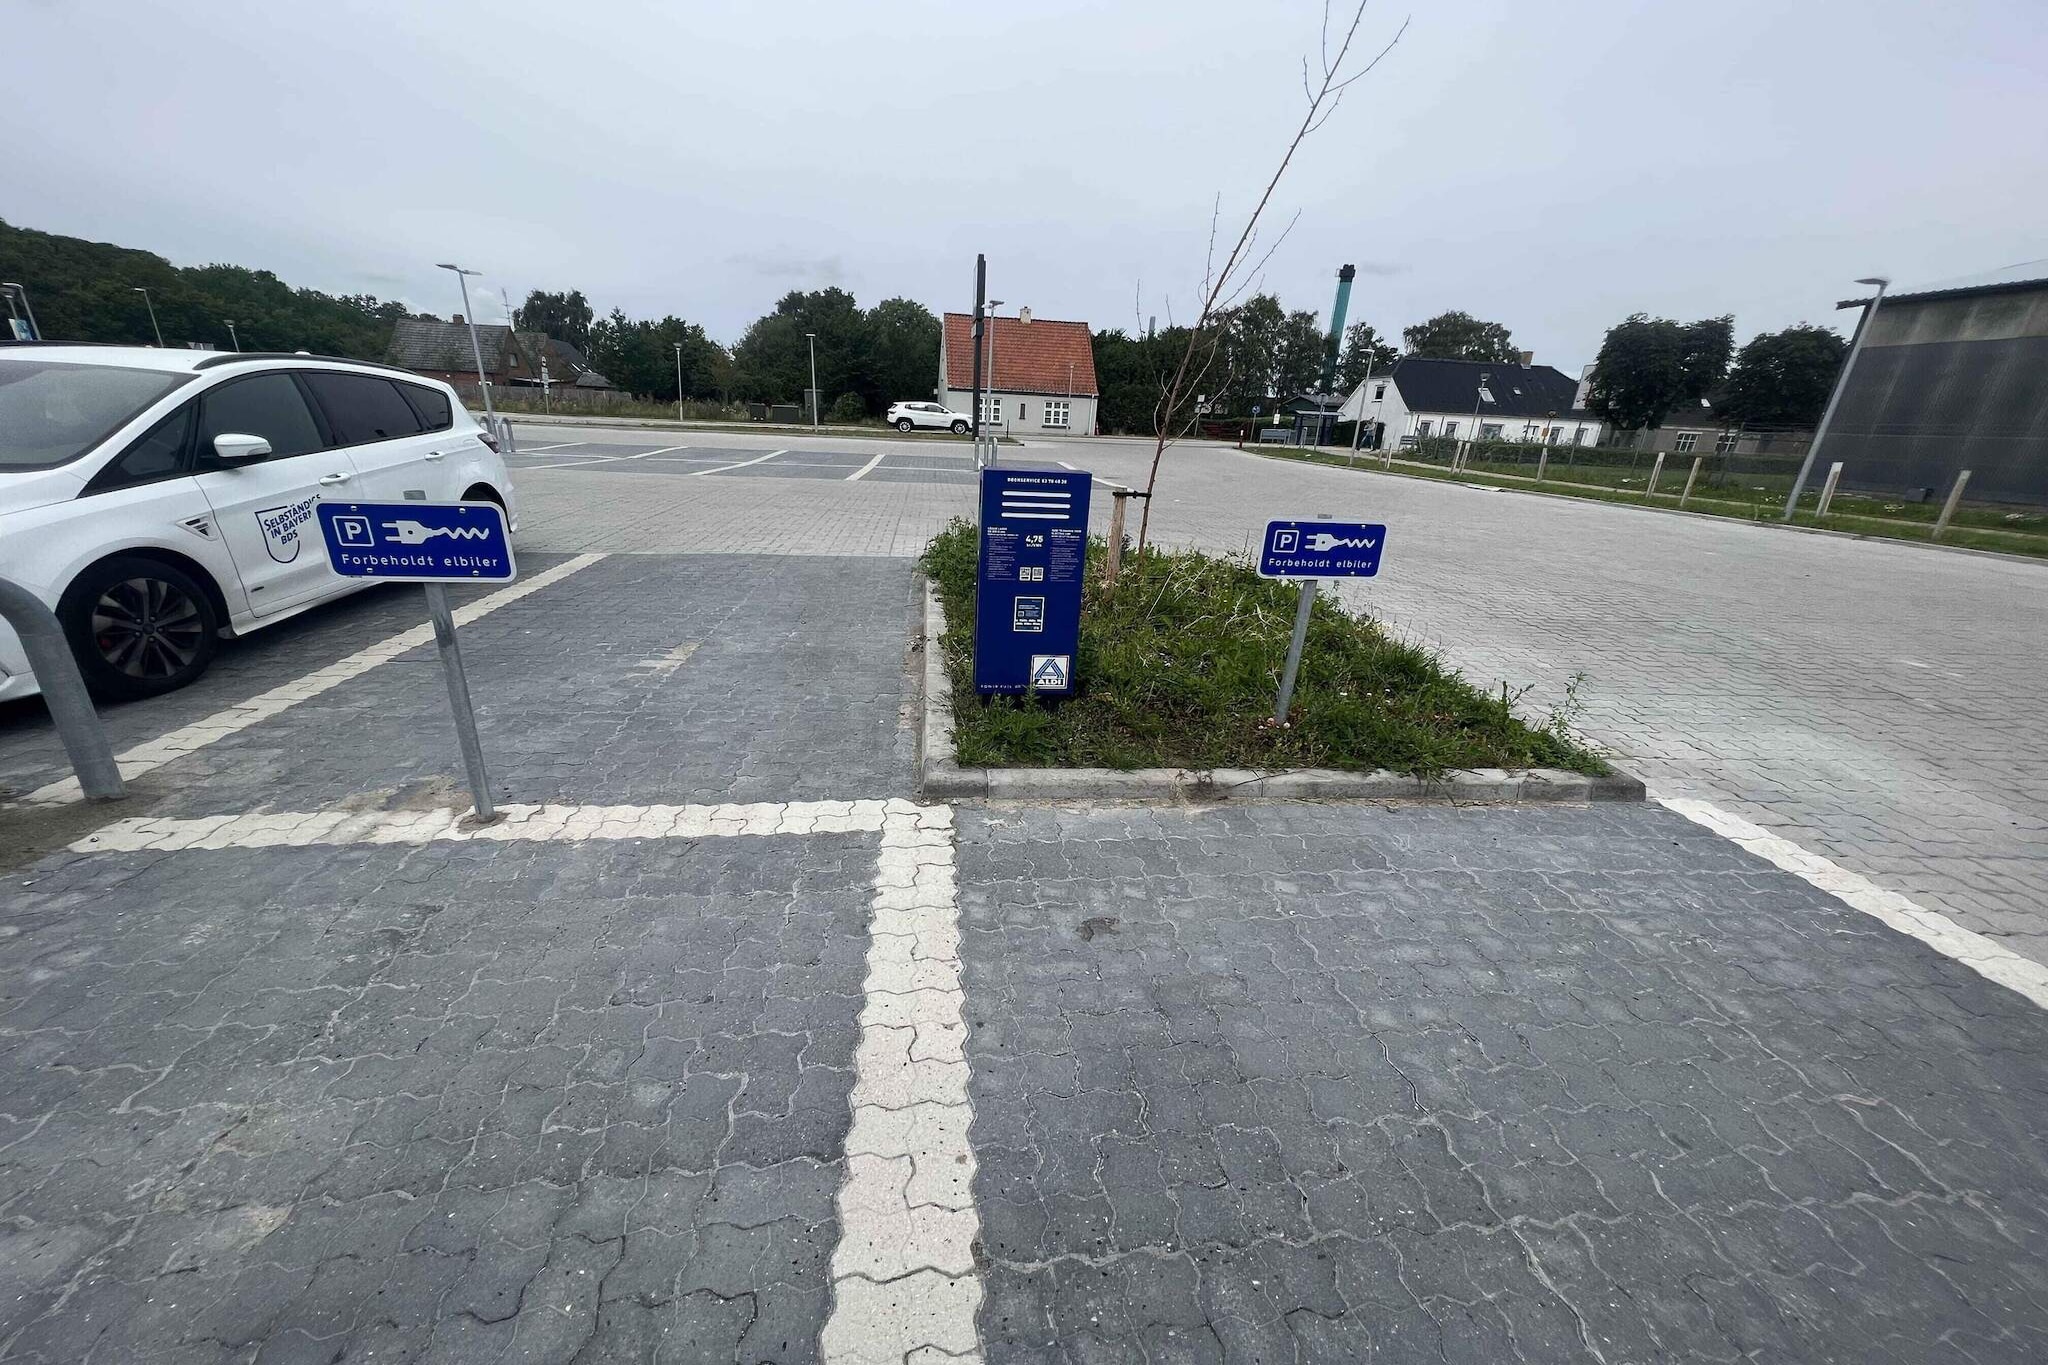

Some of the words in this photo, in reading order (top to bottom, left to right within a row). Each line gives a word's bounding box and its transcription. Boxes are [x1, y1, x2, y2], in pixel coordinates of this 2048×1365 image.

[270, 527, 282, 539] IN
[280, 529, 298, 545] BDS
[343, 521, 362, 541] P
[1025, 535, 1044, 544] 4,75
[1280, 534, 1293, 548] P
[341, 553, 434, 566] Forbeholdt
[444, 554, 498, 567] elbiler
[1268, 558, 1330, 568] Forbeholdt
[1336, 559, 1372, 569] elbiler
